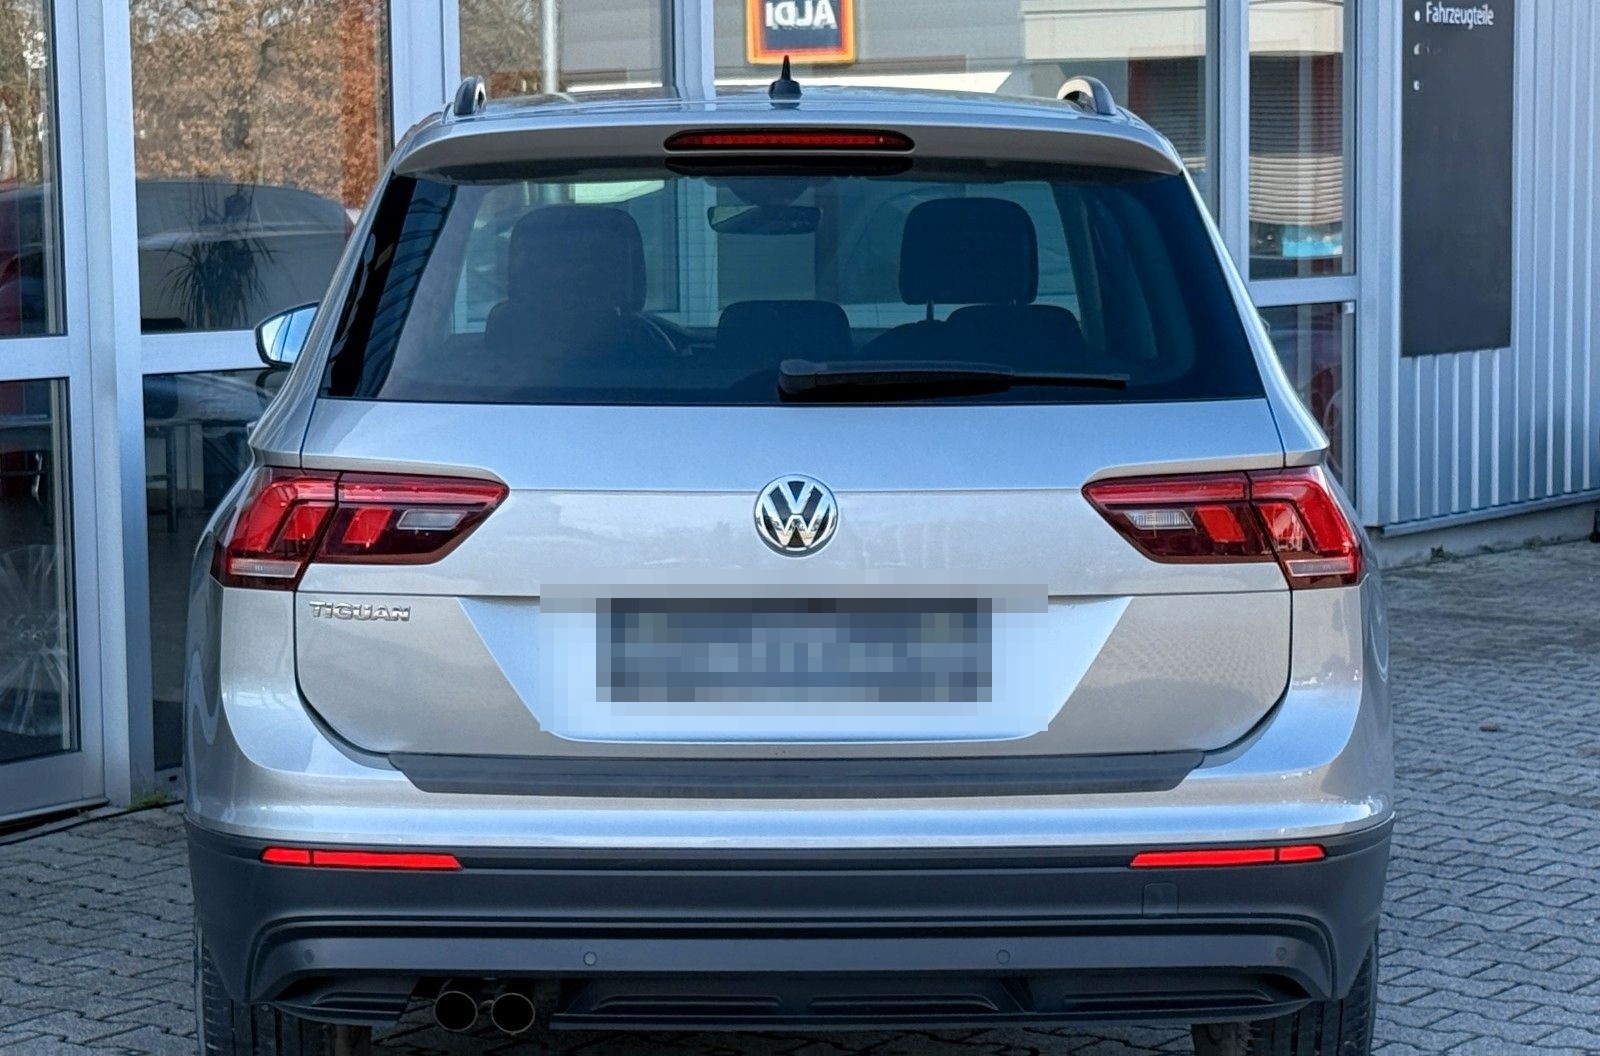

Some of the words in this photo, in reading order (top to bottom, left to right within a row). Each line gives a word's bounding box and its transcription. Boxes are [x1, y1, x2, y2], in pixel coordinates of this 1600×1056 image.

[1426, 1, 1494, 30] Fahrzeugteile
[757, 476, 835, 553] VW
[309, 601, 411, 621] TIGUAN
